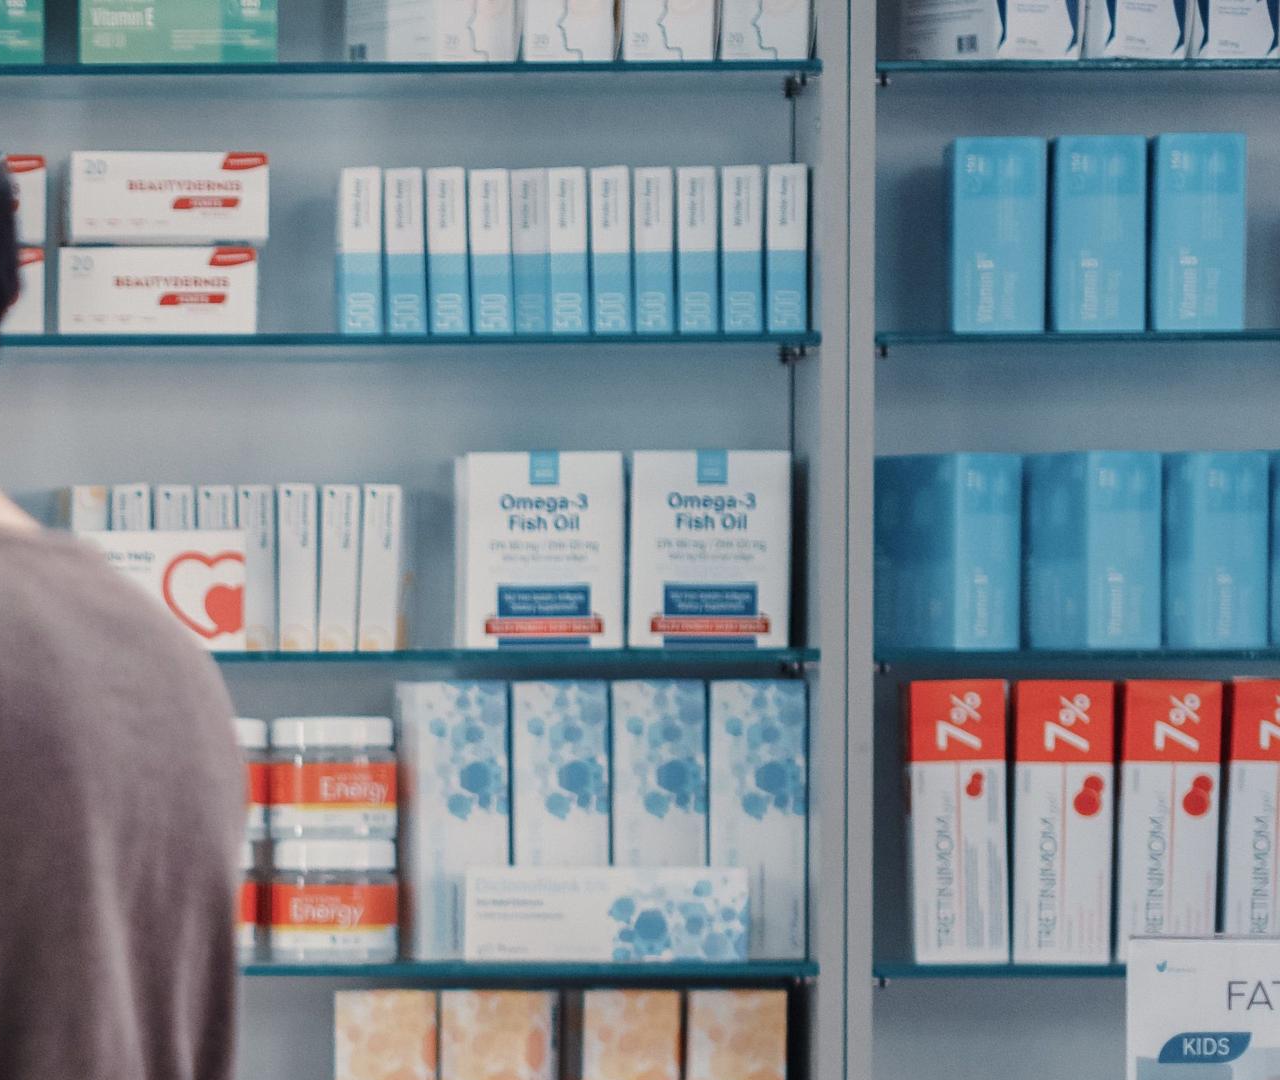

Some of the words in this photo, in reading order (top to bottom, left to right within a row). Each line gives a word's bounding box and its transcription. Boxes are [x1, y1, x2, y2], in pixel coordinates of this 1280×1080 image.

[500, 493, 589, 513] Omega-3
[667, 492, 757, 511] Omega-3
[509, 514, 548, 530] Fish
[553, 513, 581, 530] Oil
[676, 513, 714, 530] Fish
[719, 512, 748, 530] Oil
[935, 689, 983, 753] 7%
[1043, 691, 1091, 754] 7%
[1152, 692, 1201, 754] 7%
[319, 776, 389, 804] Energy
[289, 896, 365, 928] Energy
[1183, 1037, 1231, 1057] KIDS
